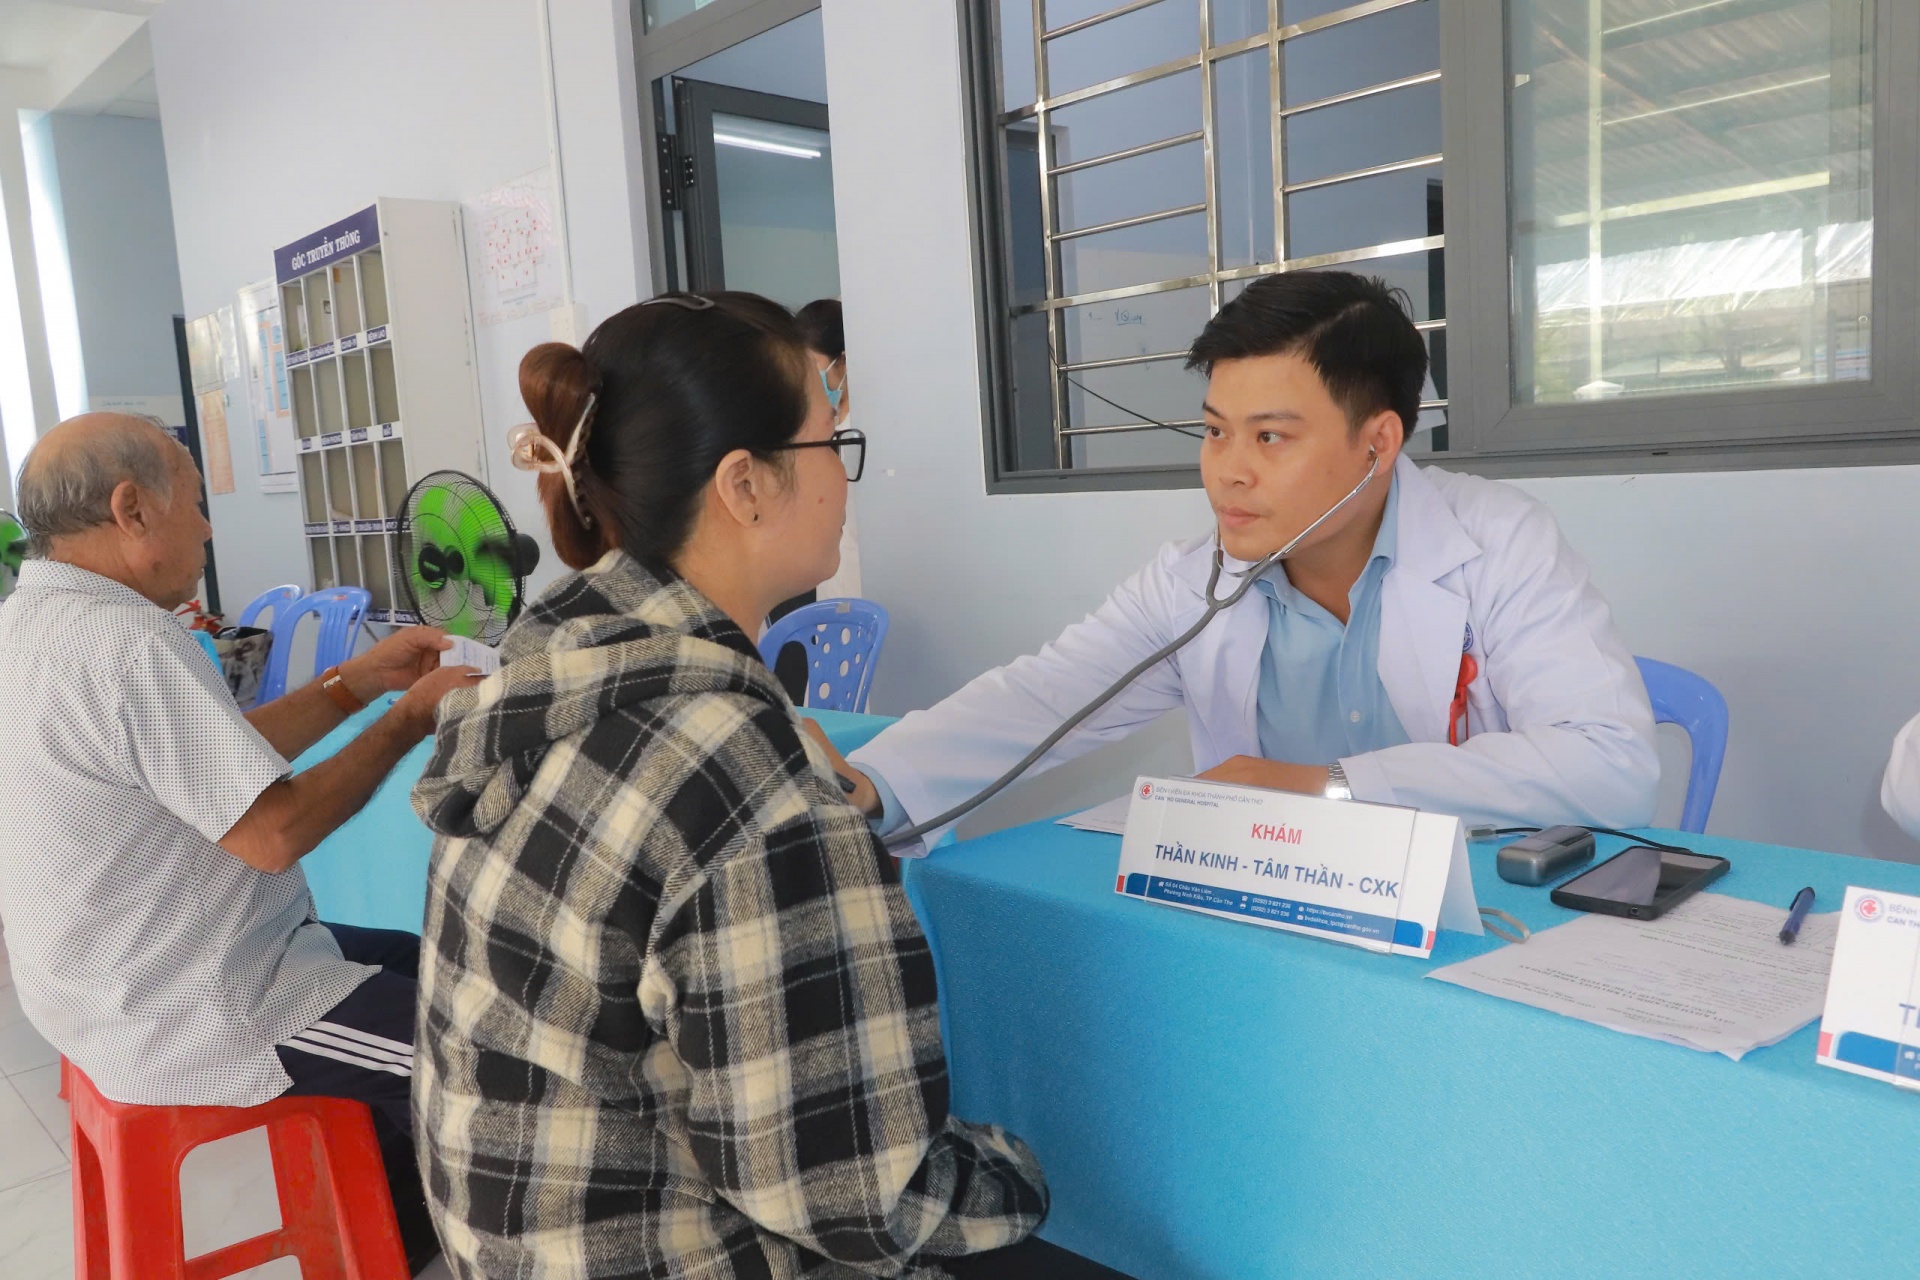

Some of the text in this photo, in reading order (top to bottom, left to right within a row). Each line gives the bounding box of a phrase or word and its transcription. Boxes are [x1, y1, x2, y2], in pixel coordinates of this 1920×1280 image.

[291, 230, 360, 270] GÓC TRUYỀN THÔNG
[1175, 797, 1196, 805] GENERAL
[1197, 800, 1219, 808] HOSPITAL
[1251, 823, 1302, 845] KHÁM
[1154, 841, 1196, 865] THẦN
[1199, 852, 1239, 872] KINH
[1253, 858, 1289, 880] TÂM
[1294, 864, 1343, 889] THẦN
[1359, 876, 1400, 899] CXK
[1887, 916, 1906, 925] CAN
